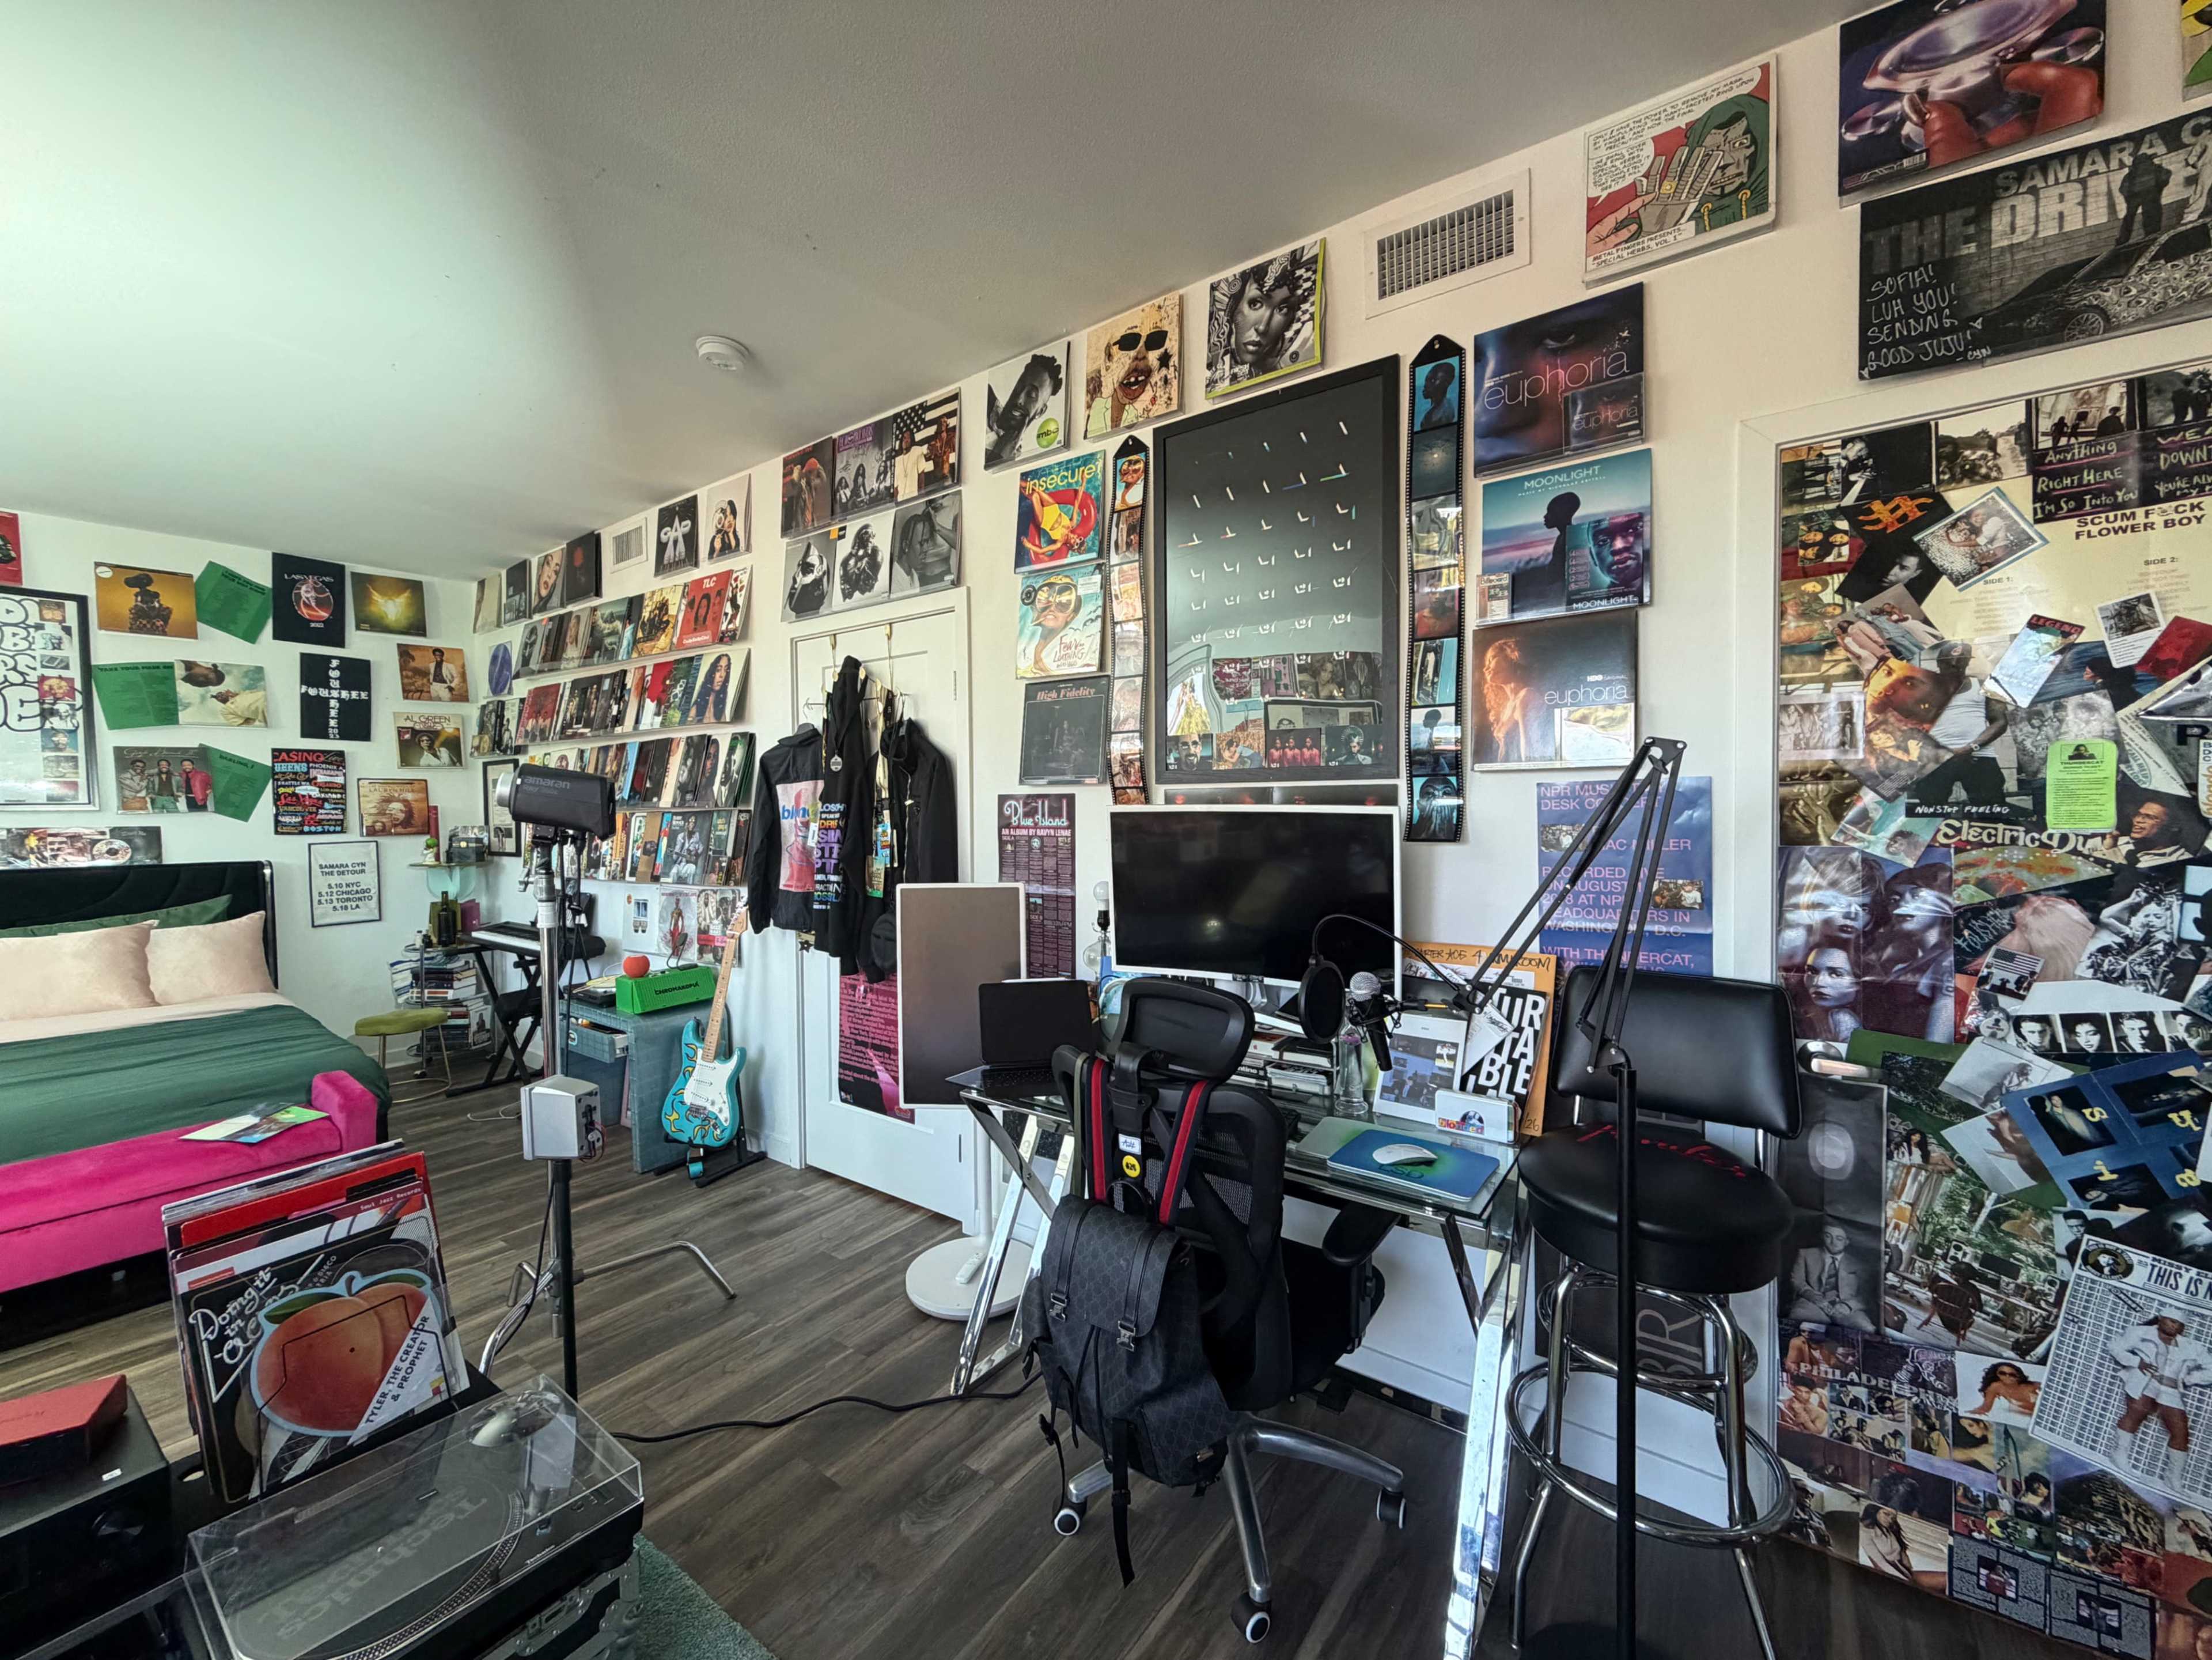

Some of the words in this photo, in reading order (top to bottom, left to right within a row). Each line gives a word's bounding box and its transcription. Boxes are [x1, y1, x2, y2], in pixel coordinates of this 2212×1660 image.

[1716, 86, 1733, 97] RING
[1736, 77, 1754, 88] UPON
[1995, 131, 2167, 199] SAMARA
[1592, 251, 1614, 262] METAL
[1615, 240, 1645, 256] FINGERS
[1863, 207, 1979, 275] THE
[1866, 264, 1937, 302] SOFIA!
[1873, 298, 1905, 323] LUH
[1912, 283, 1958, 314] YOU!
[1866, 308, 1958, 345] SENDING
[1868, 346, 1915, 371] GOOD
[1918, 330, 1972, 361] JUJU!
[1484, 351, 1630, 410] euphoria
[2045, 442, 2118, 464] ANYTHING
[1025, 463, 1096, 495] insecure
[1524, 465, 1601, 490] MOONLIGHT
[2037, 474, 2081, 494] RIGHT
[2083, 467, 2123, 484] HERE
[2034, 502, 2055, 519] I'M
[2058, 498, 2075, 514] SO
[2084, 495, 2114, 511] INTO
[2116, 488, 2139, 502] YOU
[2075, 521, 2156, 540] FLOWER
[2163, 513, 2207, 529] BOY
[2077, 511, 2137, 528] SCUM
[2143, 557, 2168, 566] SIDE
[702, 576, 717, 589] TLC
[1983, 577, 2004, 585] SIDE
[1573, 594, 1633, 611] MOONLIGHT
[2029, 615, 2082, 634] LEGEND
[1037, 690, 1058, 701] High
[1060, 686, 1096, 698] Fidelity
[1544, 684, 1629, 706] euphoria
[404, 715, 416, 723] AL
[418, 714, 452, 724] GREEN
[524, 776, 571, 790] amaran
[1540, 784, 1570, 797] NPR
[1004, 800, 1034, 826] Blue
[1035, 798, 1068, 826] Island
[1540, 799, 1580, 810] DESK
[1915, 804, 1959, 814] NONSTOP
[1964, 803, 2011, 814] FEELING
[1010, 828, 1028, 836] ALBUM
[1029, 828, 1036, 836] BY
[1936, 818, 2041, 848] Electric
[336, 868, 366, 876] DETOUR
[335, 895, 373, 904] TORONTO
[336, 888, 372, 896] CHICAGO
[1578, 894, 1596, 905] AT
[1674, 910, 1691, 922] IN
[1654, 925, 1686, 937] D.C.
[1543, 946, 1580, 959] WITH
[1438, 1117, 1485, 1135] blonded
[360, 1202, 375, 1211] Soul
[396, 1188, 421, 1198] Records
[2147, 1263, 2183, 1291] THIS
[2184, 1276, 2203, 1297] IS
[188, 1287, 259, 1341] Doing
[365, 1389, 392, 1424] TYLER,
[387, 1365, 403, 1386] THE
[399, 1315, 430, 1364] CREATOR
[391, 1393, 401, 1402] &
[398, 1340, 428, 1389] PROPHET
